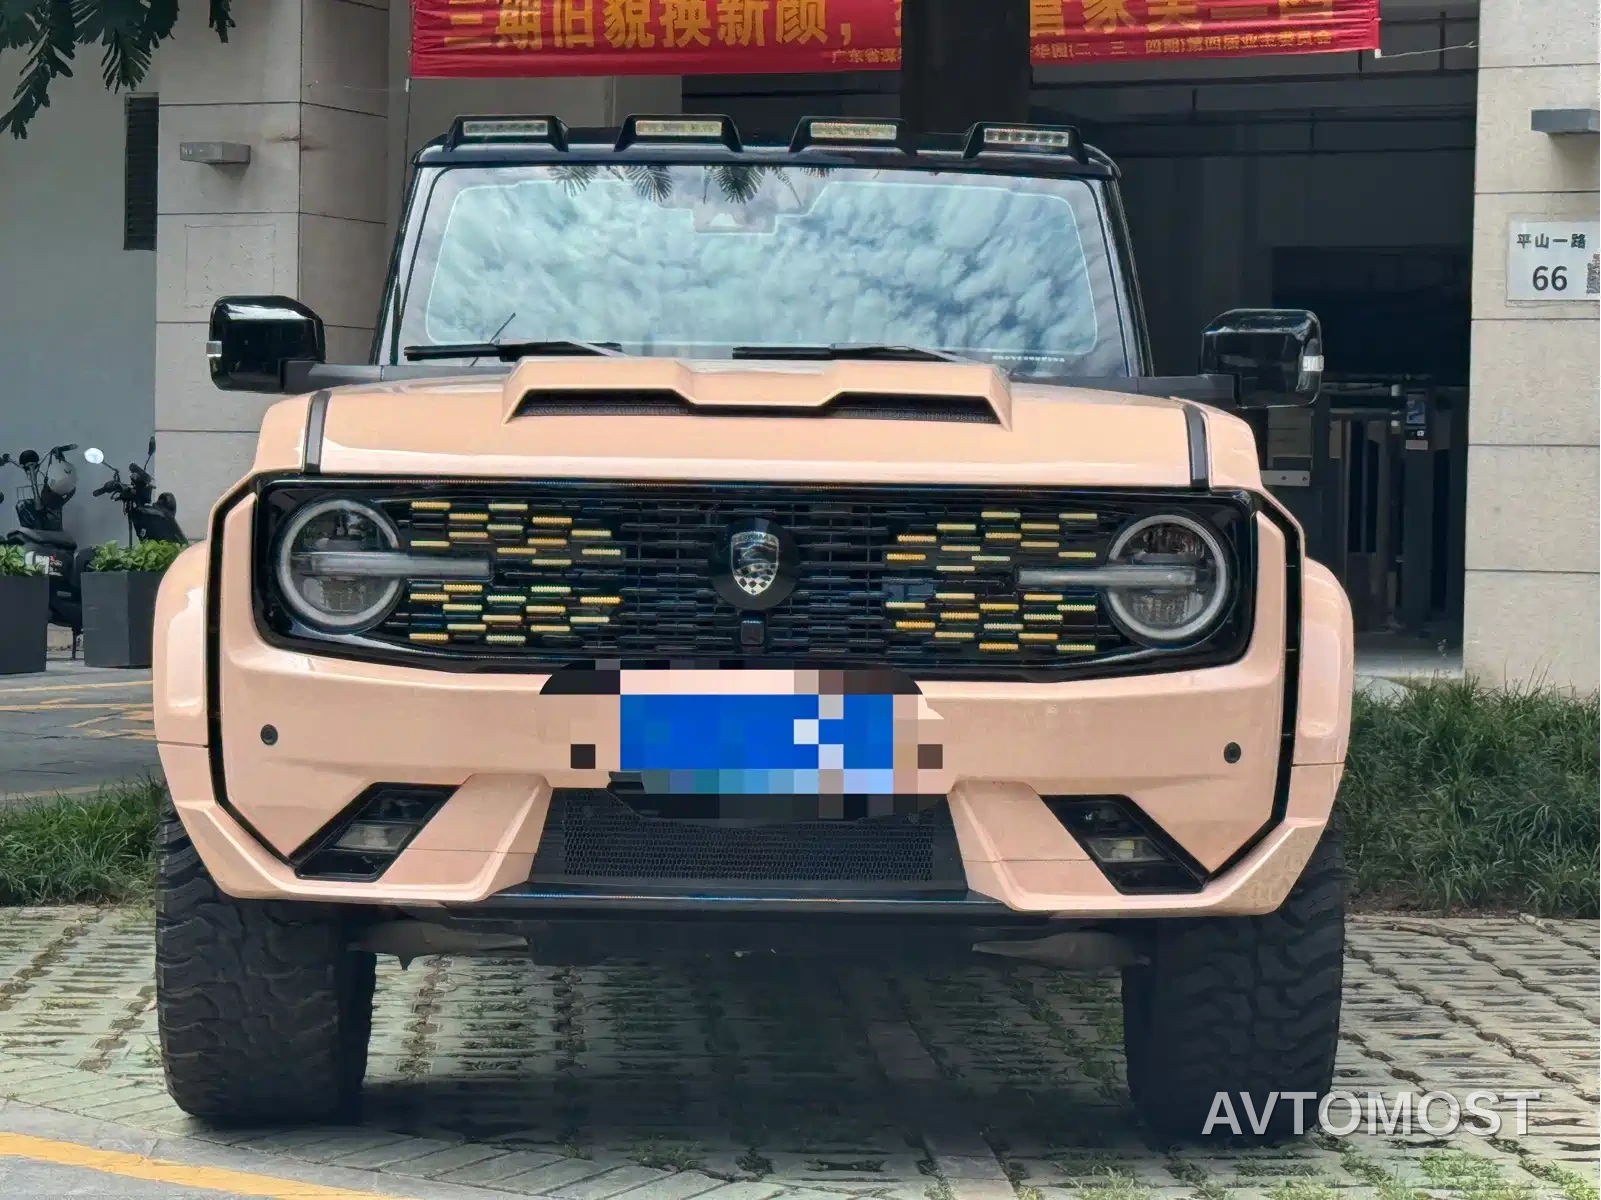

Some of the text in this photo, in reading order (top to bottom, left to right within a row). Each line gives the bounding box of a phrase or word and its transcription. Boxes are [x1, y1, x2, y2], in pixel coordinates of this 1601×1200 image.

[443, 0, 902, 49] 三期旧貌换新颜，
[832, 47, 902, 63] 广东省深
[1516, 233, 1586, 249] 平山一路
[1533, 266, 1567, 291] 66
